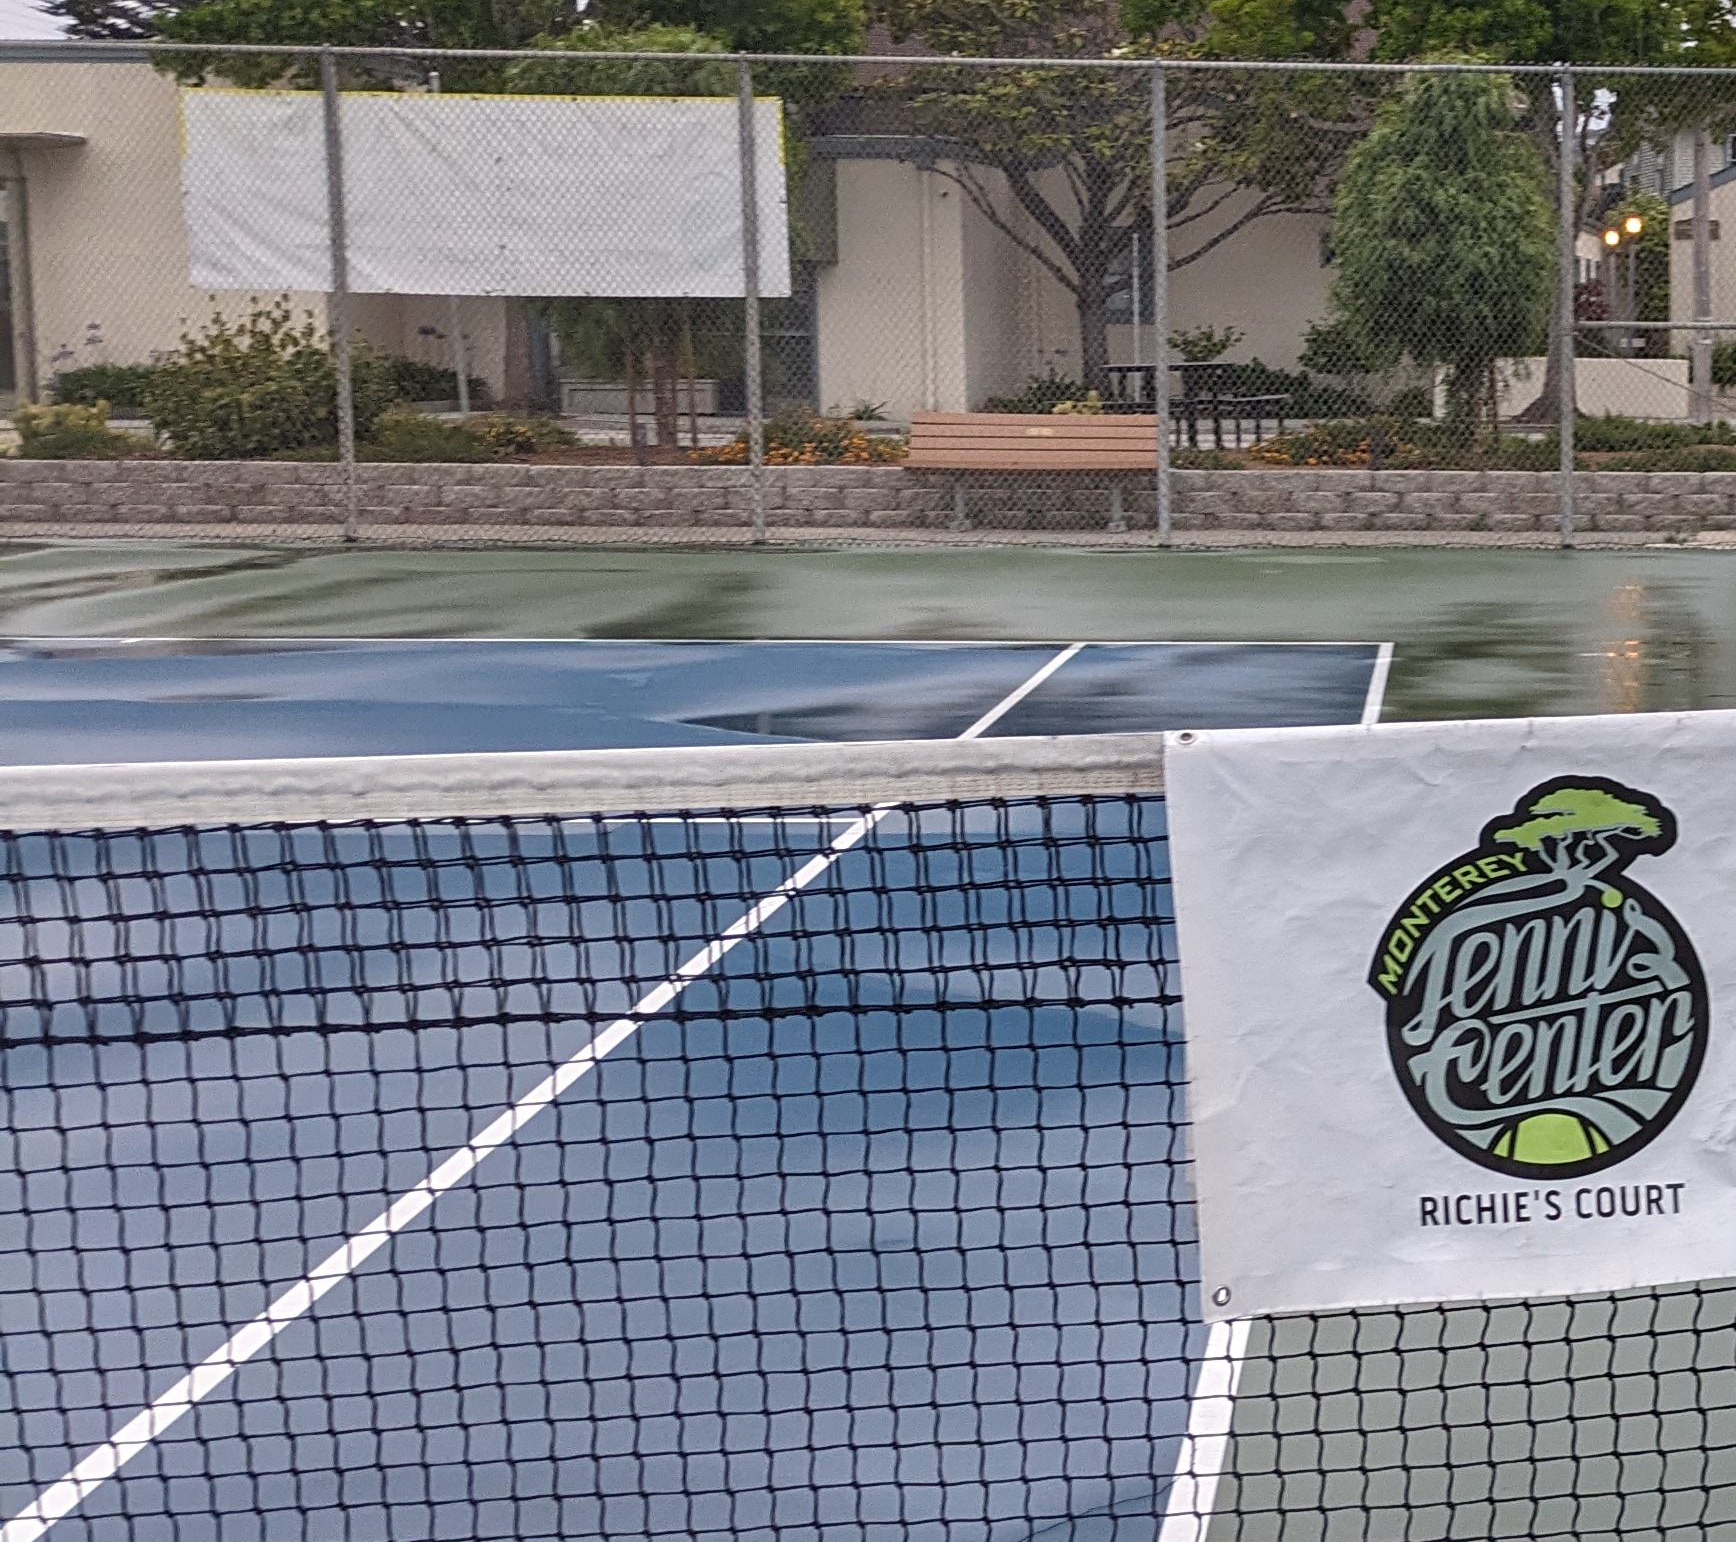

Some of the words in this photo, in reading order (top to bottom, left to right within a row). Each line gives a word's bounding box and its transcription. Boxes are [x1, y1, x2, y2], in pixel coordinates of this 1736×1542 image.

[1377, 852, 1529, 995] MONTEREY
[1401, 897, 1691, 1047] Tennis
[1406, 990, 1696, 1126] Center
[1419, 1189, 1562, 1227] RICHIE'S
[1574, 1182, 1686, 1220] COURT
